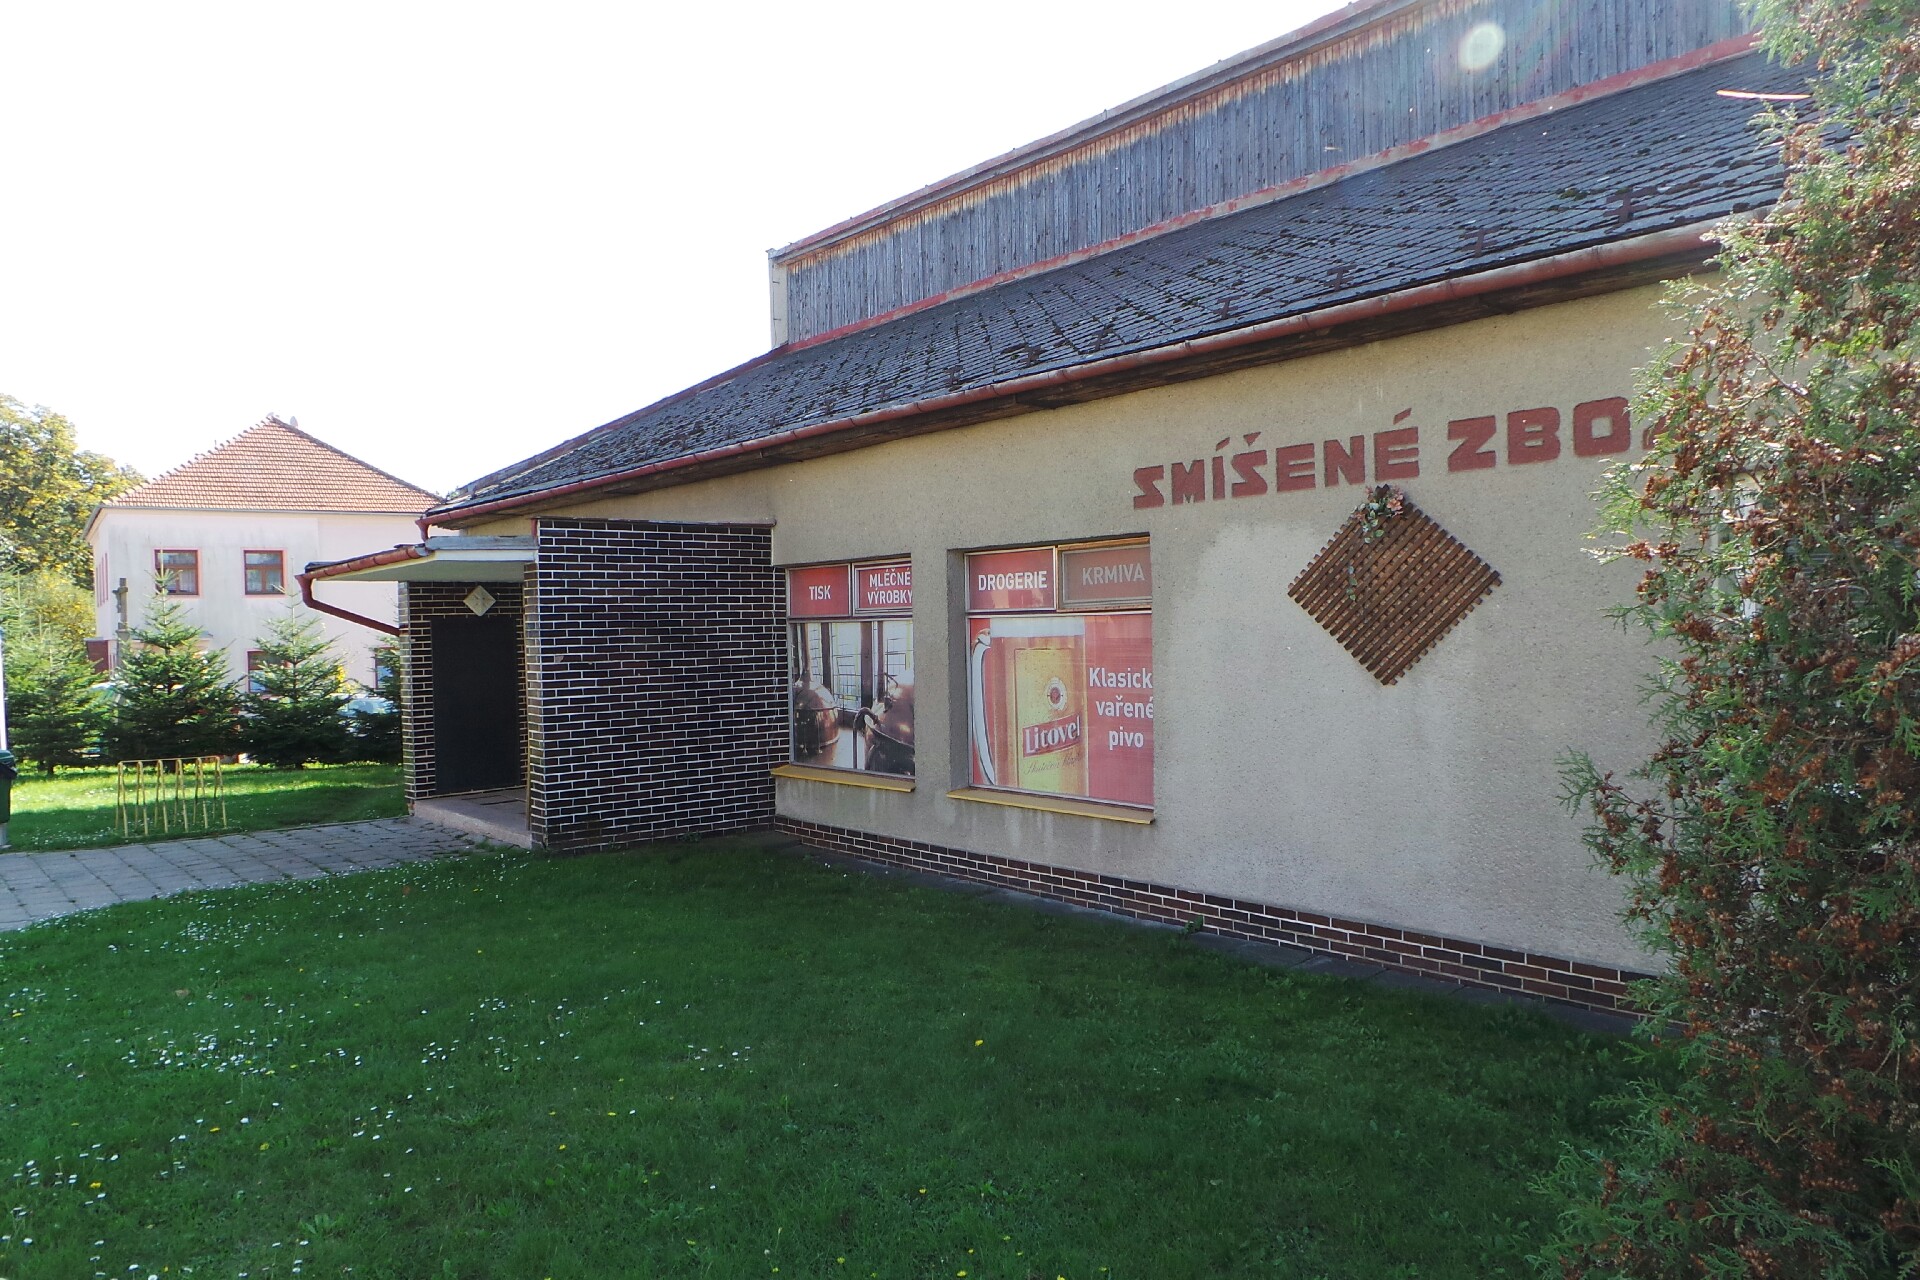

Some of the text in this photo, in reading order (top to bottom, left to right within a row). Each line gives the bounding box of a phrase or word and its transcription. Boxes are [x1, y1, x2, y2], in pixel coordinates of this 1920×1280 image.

[1133, 407, 1419, 509] SMÍŠENÉ
[869, 567, 911, 588] MLÉČNÉ
[978, 570, 1048, 591] DROGERIE
[1082, 562, 1146, 586] KRMIVA
[808, 585, 832, 600] TISK
[867, 587, 912, 606] VÝROBKY
[1089, 667, 1153, 689] Klasick
[1095, 694, 1154, 719] vařené
[1108, 726, 1144, 751] pivo
